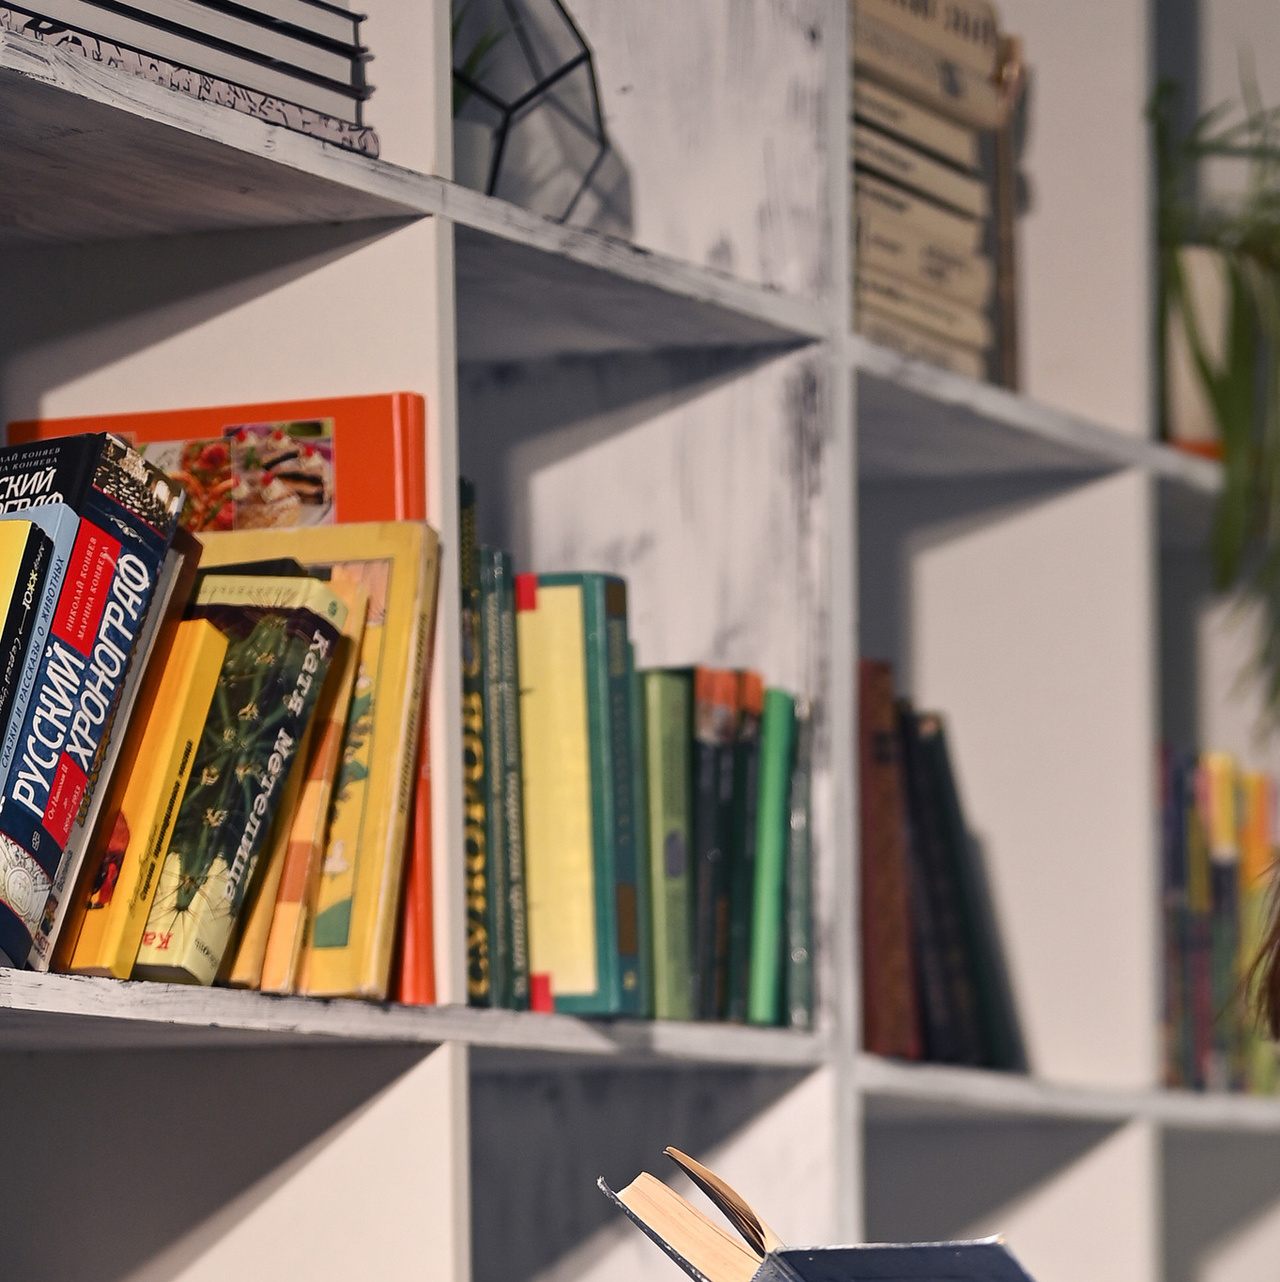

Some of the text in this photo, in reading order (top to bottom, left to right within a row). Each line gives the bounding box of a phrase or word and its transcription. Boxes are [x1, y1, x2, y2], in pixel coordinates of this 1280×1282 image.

[12, 457, 58, 472] КОНЯЕВА
[21, 447, 61, 461] КОНЯЕВ
[66, 537, 97, 633] НИКОЛАЙ КОНЯЕВ
[77, 544, 109, 641] МАРИНА КОНЯЕВА
[1, 720, 20, 769] СКАЗКИ
[19, 641, 40, 704] РАССКАЗЫ
[40, 556, 65, 624] ЖИВОТНЫХ
[12, 641, 85, 819] РУССКИЙ
[65, 553, 151, 772] ХРОНОГРАФ
[222, 629, 330, 902] Катя Метелица
